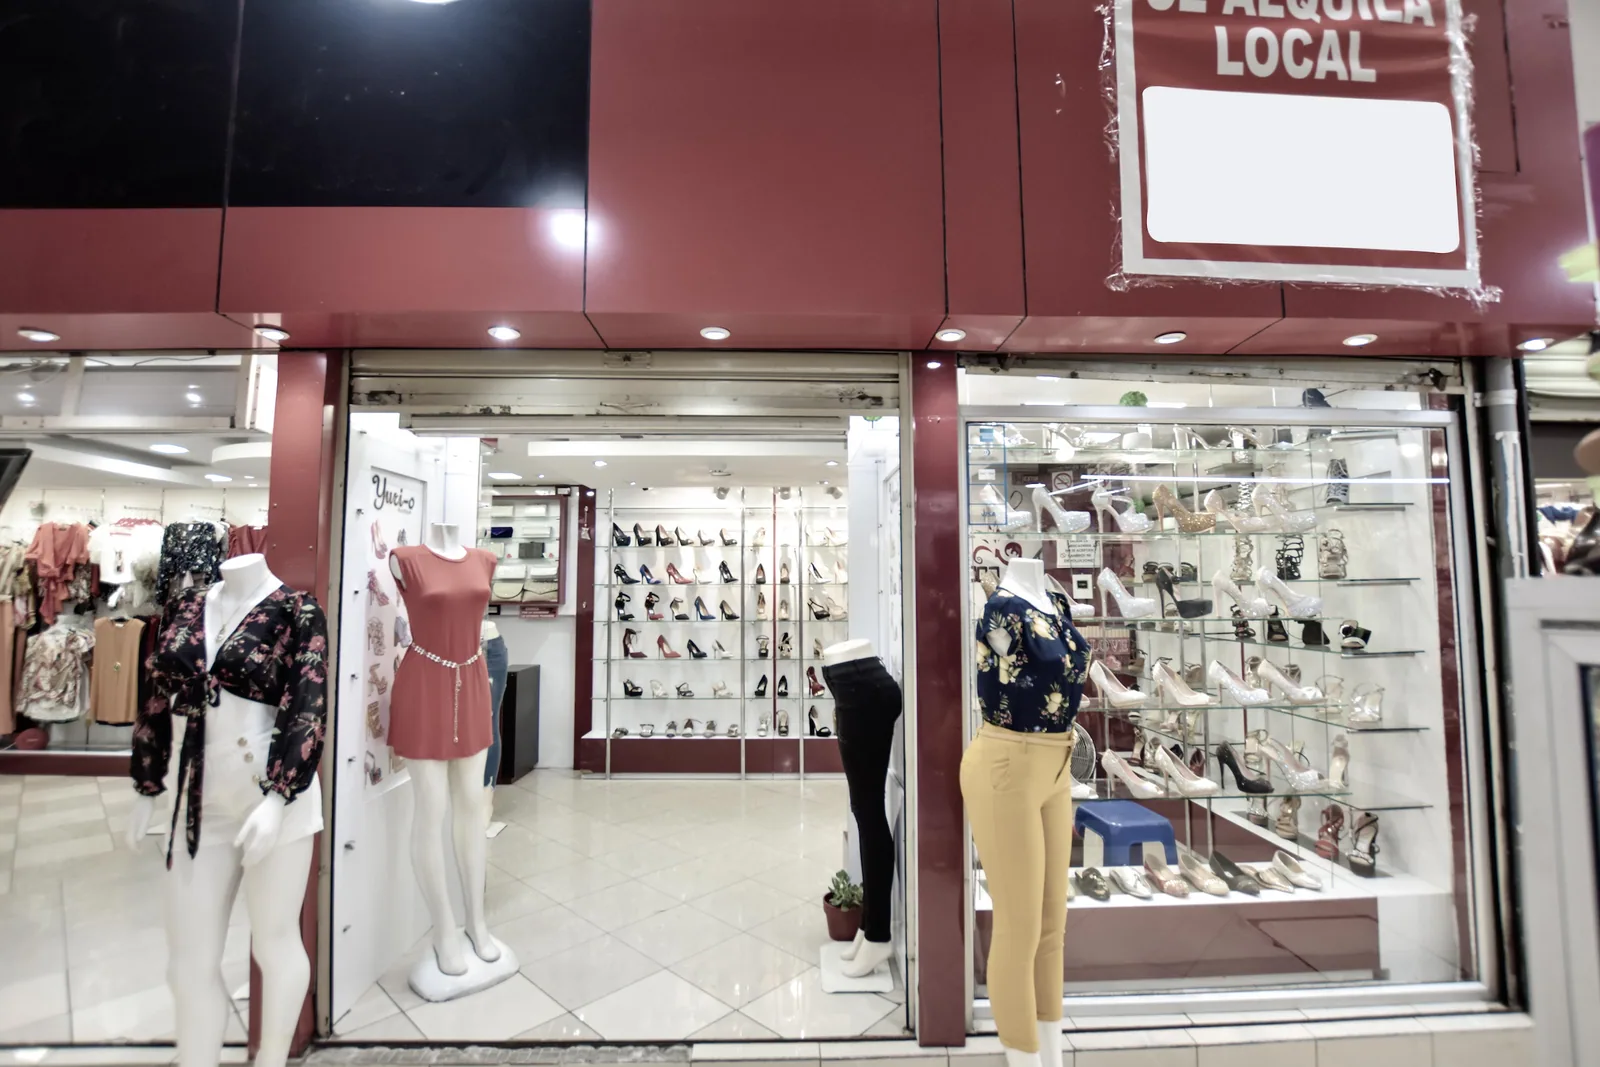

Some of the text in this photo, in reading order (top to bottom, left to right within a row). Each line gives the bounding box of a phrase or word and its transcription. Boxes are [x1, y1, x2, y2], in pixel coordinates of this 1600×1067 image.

[1214, 25, 1377, 83] LOCAL
[372, 474, 415, 510] Yuri-o
[1089, 639, 1129, 652] LOVE
